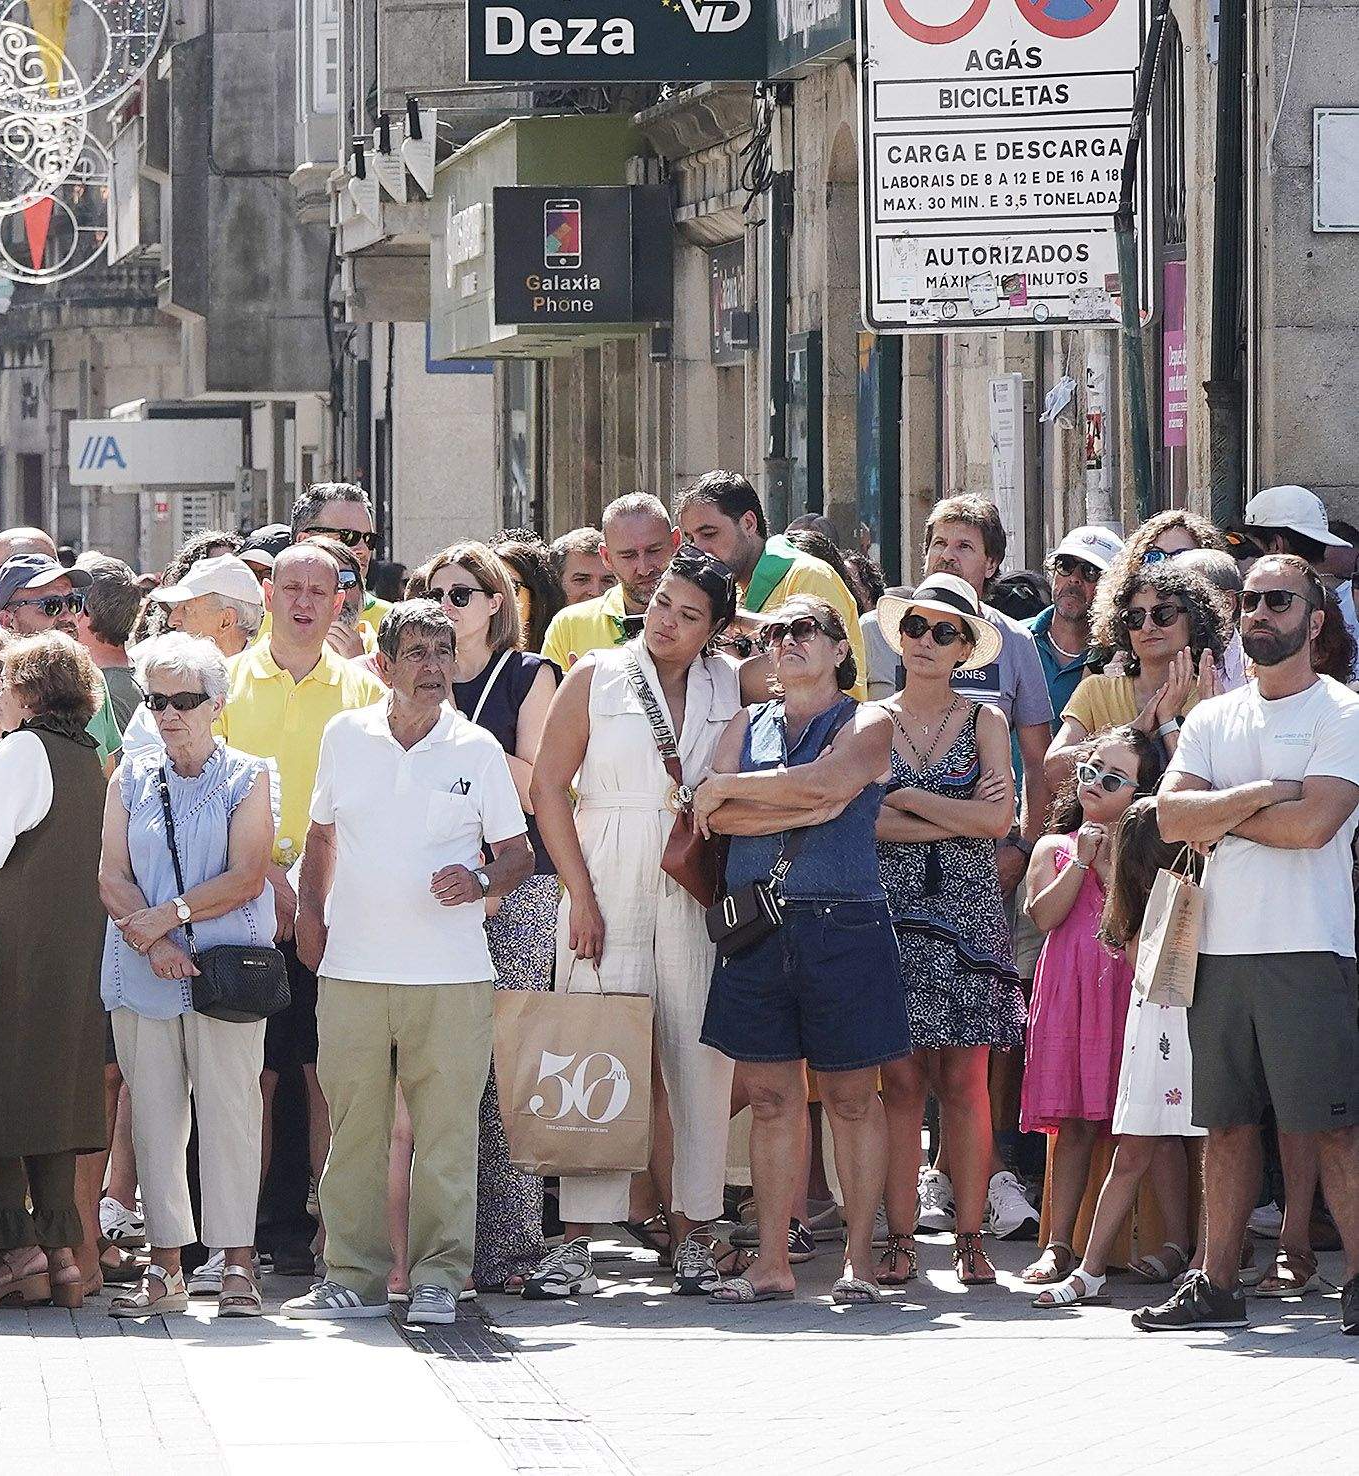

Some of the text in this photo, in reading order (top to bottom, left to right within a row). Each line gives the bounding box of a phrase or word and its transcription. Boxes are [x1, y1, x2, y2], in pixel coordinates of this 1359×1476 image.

[485, 6, 635, 56] Deza
[965, 39, 1042, 72] AGÁS
[939, 83, 1070, 109] BICICLETAS
[887, 138, 1123, 164] CARGA E DESCARGA
[882, 174, 955, 189] LABORAIS
[960, 173, 979, 187] DE
[984, 173, 993, 186] 8
[998, 172, 1009, 186] A
[1013, 172, 1027, 185] 12
[1032, 171, 1041, 184] E
[1046, 170, 1065, 184] DE
[1070, 169, 1084, 183] 16
[1090, 169, 1100, 182] A
[883, 190, 1122, 211] MAX: 30 MIN. E 3,5 TONELADA
[925, 243, 1089, 267] AUTORIZADOS
[526, 274, 601, 291] Galaxia
[1027, 271, 1088, 286] INUTOS
[533, 296, 594, 312] Phone
[951, 669, 987, 680] JONES
[529, 1050, 631, 1124] 50
